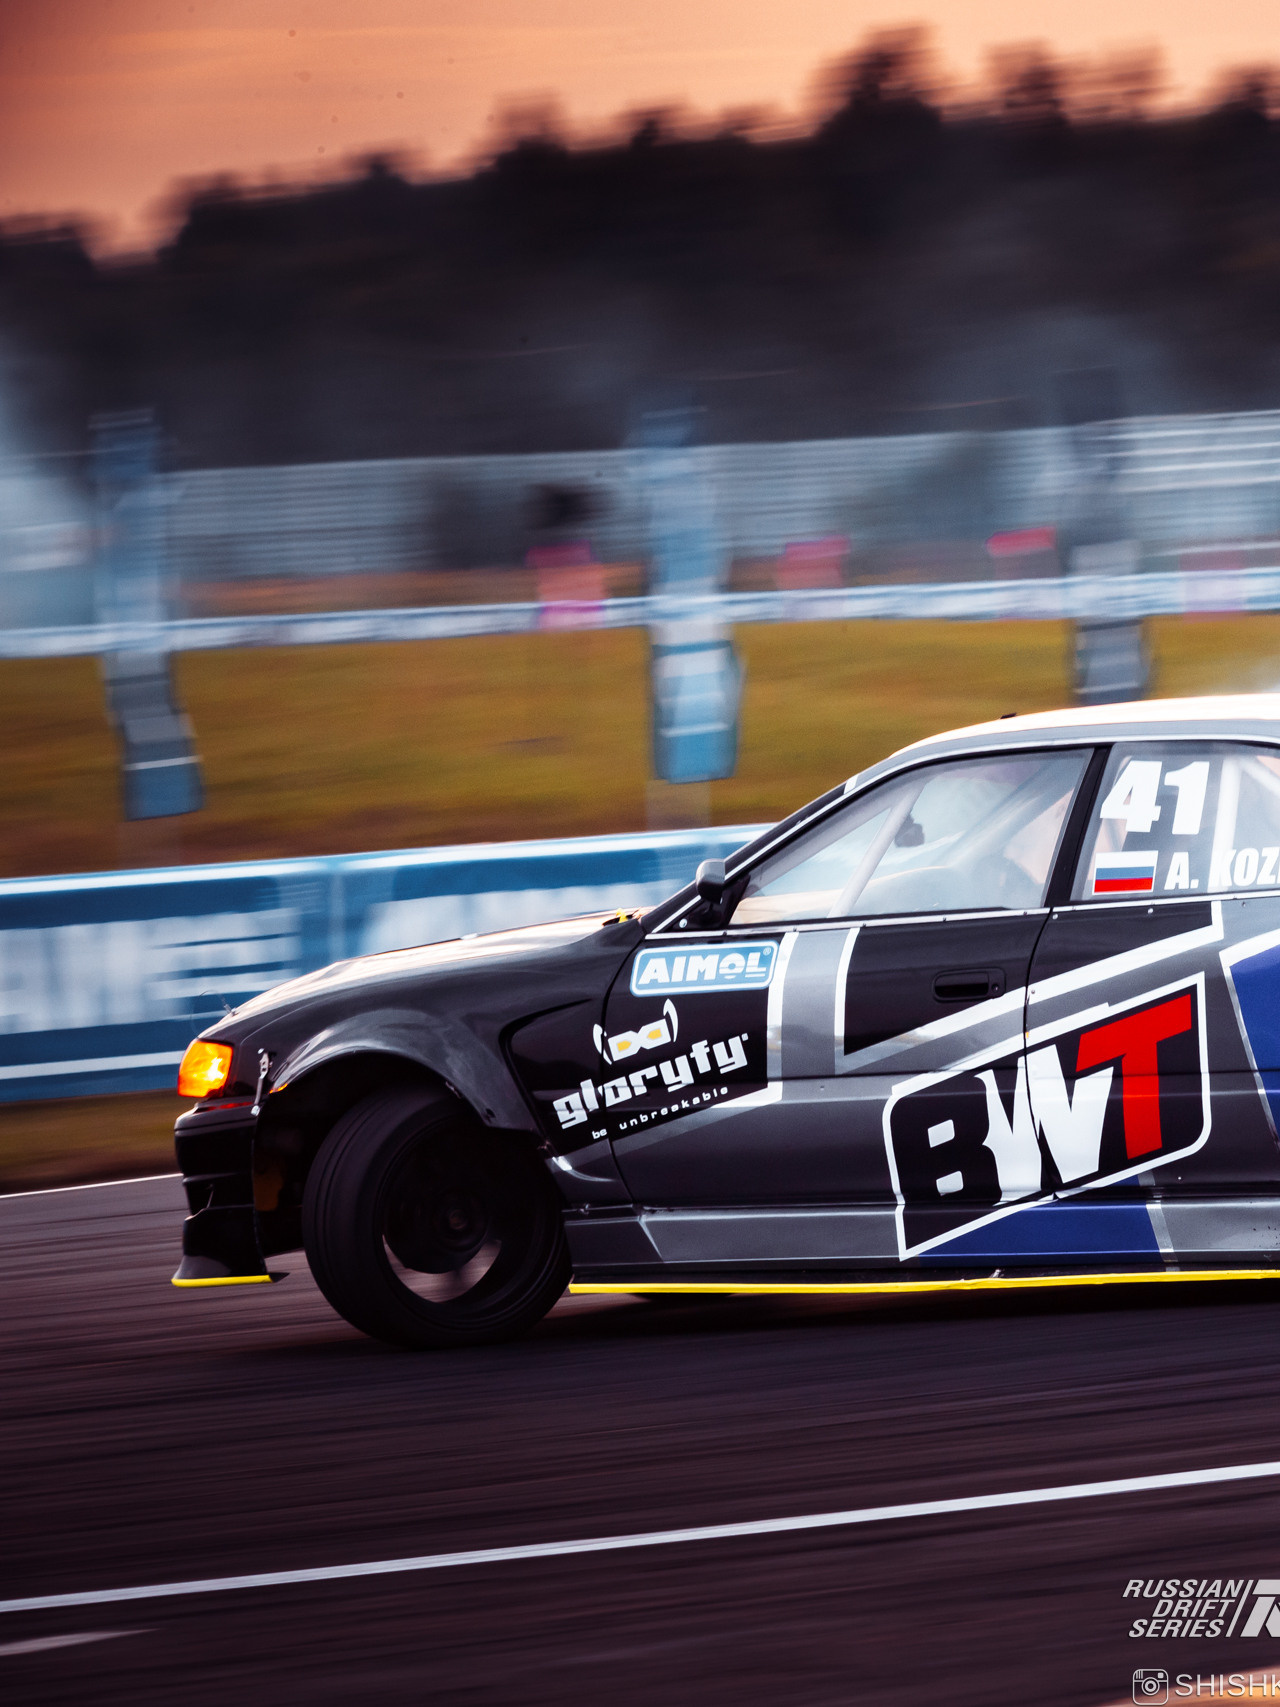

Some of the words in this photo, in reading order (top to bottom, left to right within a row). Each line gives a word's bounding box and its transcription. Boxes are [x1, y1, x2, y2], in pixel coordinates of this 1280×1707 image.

[1100, 760, 1210, 835] 41
[1164, 851, 1199, 890] A.
[638, 953, 768, 984] AIMOL
[552, 1038, 748, 1130] gloryfy
[591, 1127, 608, 1140] be
[618, 1086, 728, 1130] unbreakable
[902, 993, 1192, 1207] BWT
